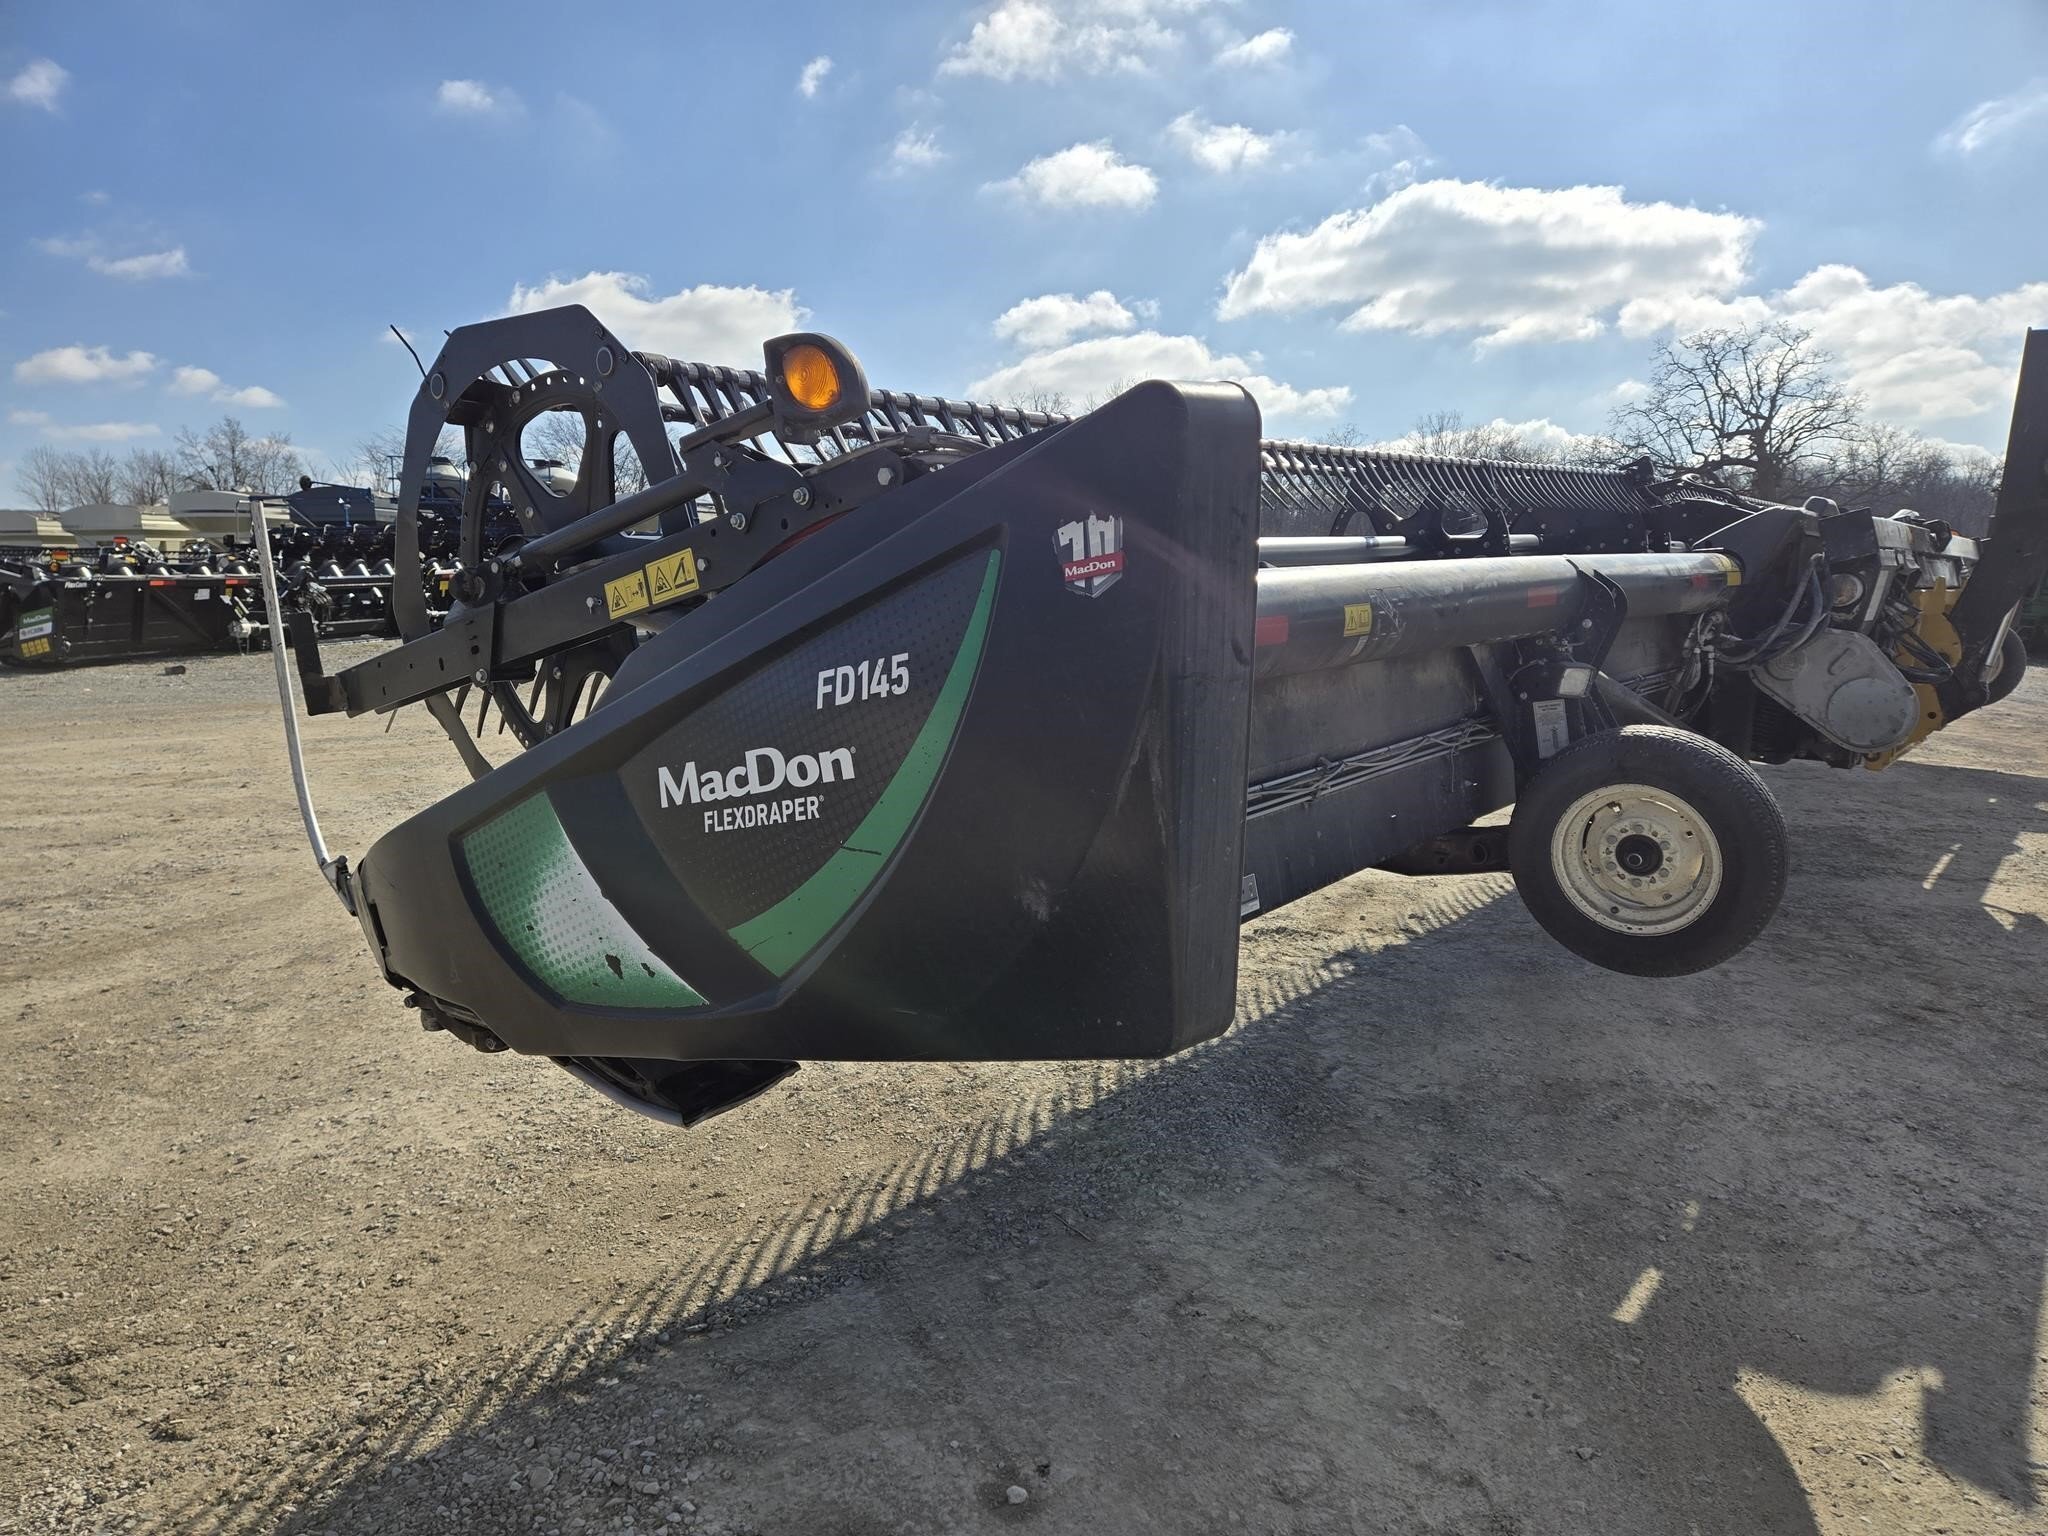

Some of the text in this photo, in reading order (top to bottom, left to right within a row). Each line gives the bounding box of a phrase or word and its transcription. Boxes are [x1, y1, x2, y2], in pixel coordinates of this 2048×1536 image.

[1064, 559, 1117, 577] MacDon
[816, 652, 910, 710] FD145
[658, 747, 856, 809] MacDon
[703, 796, 821, 833] FLEXDRAPER
